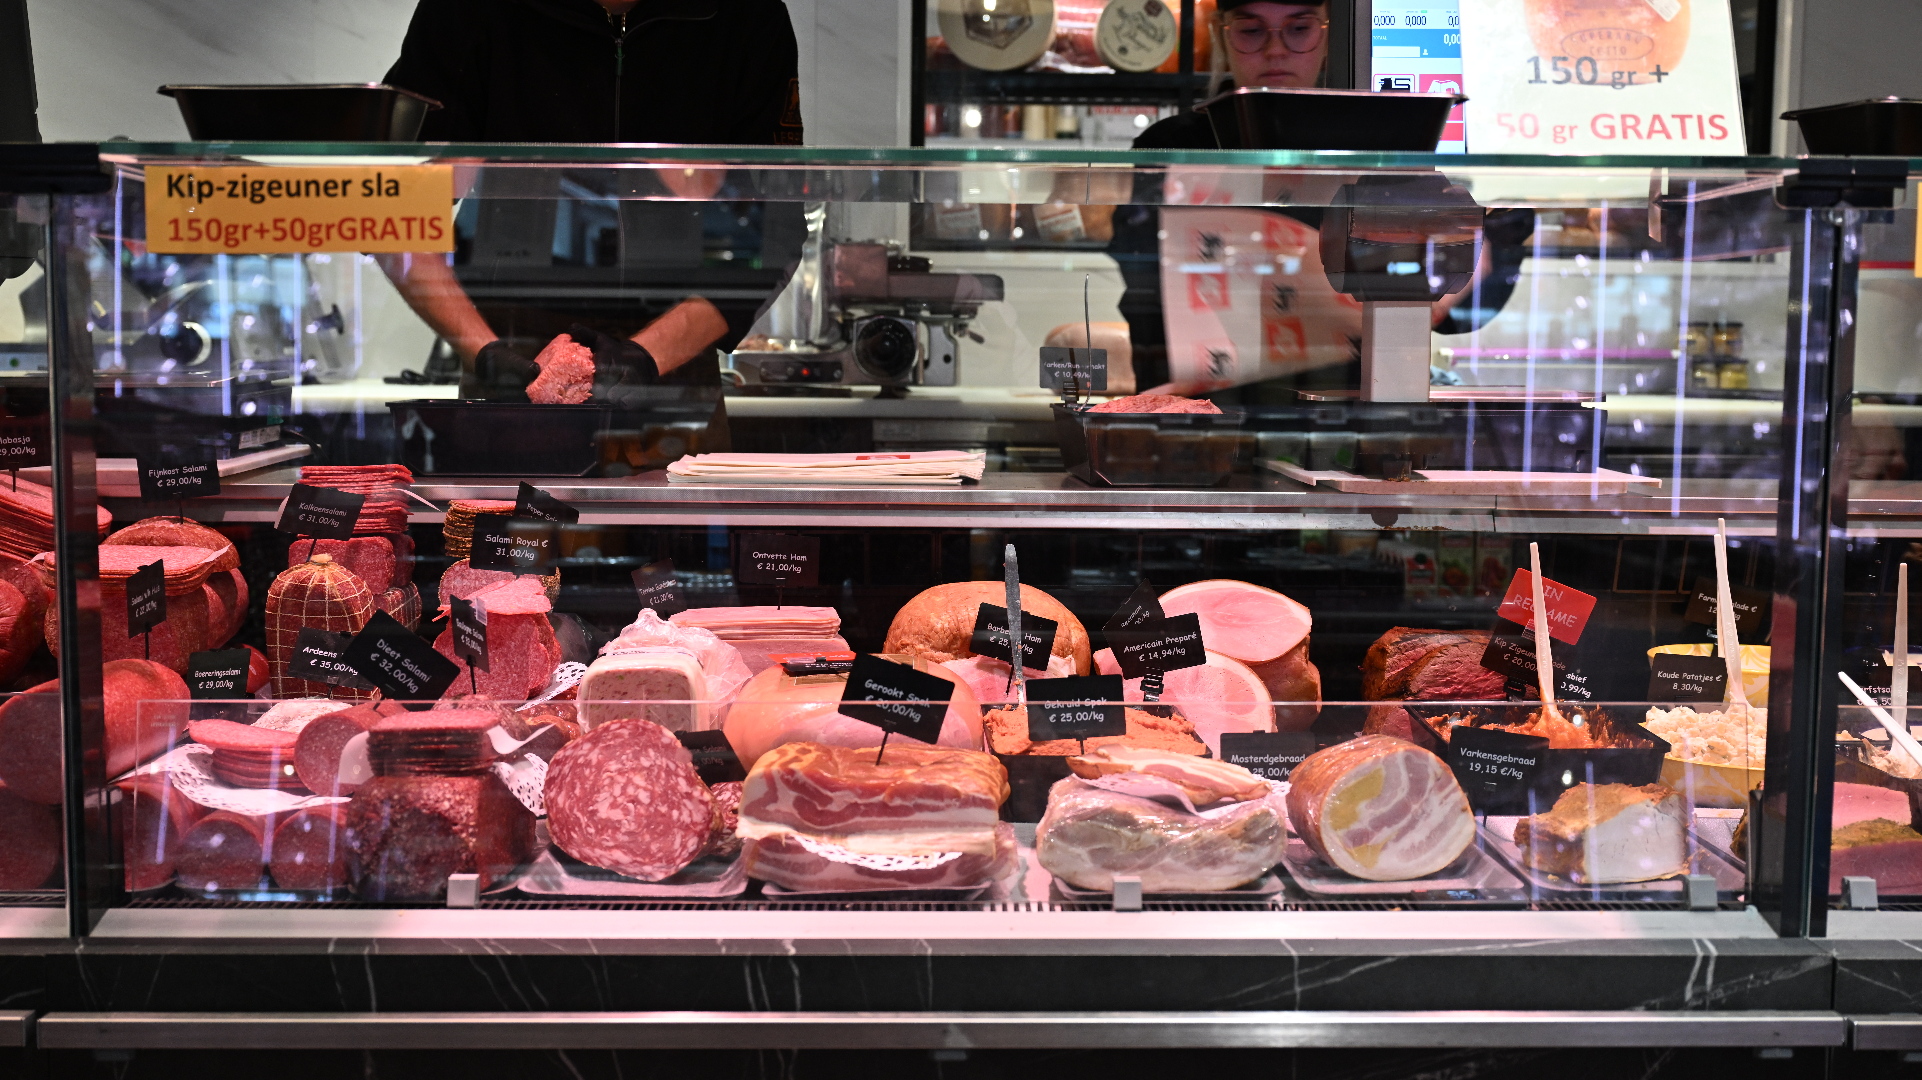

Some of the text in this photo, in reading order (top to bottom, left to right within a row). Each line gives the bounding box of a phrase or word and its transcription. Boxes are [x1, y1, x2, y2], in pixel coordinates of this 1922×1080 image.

[1526, 55, 1669, 90] 150 gr +
[1496, 112, 1729, 145] 50 gr GRATIS
[166, 172, 401, 204] Kip-zigeuner sla
[168, 215, 444, 248] 150gr+50grGRATIS
[182, 463, 208, 474] Salami
[157, 479, 163, 487] €
[298, 513, 306, 521] €
[485, 534, 514, 544] Salami
[516, 536, 539, 548] Royal
[495, 547, 535, 561] 31,00/kg
[752, 551, 808, 562] Ontvette Ham
[756, 562, 802, 574] € 21,00/kg
[1543, 585, 1564, 602] IN
[1513, 593, 1578, 628] RECAME
[1024, 633, 1042, 644] Ham
[1494, 636, 1507, 648] Kip
[1123, 639, 1163, 653] Americain
[302, 646, 338, 659] Ardeens
[370, 652, 380, 661] €
[1138, 654, 1145, 662] €
[310, 658, 318, 666] €
[376, 638, 432, 683] Dieet Salami
[1682, 672, 1714, 683] Patatjes
[198, 681, 205, 689] €
[864, 679, 904, 699] Gerookt
[1049, 711, 1105, 723] € 25,00/kg
[1230, 753, 1306, 765] Mosterdgebraad
[1460, 747, 1536, 766] Varkensgebraad
[1252, 767, 1291, 778] 25,00/k
[1469, 762, 1524, 780] 19,15 €/kg
